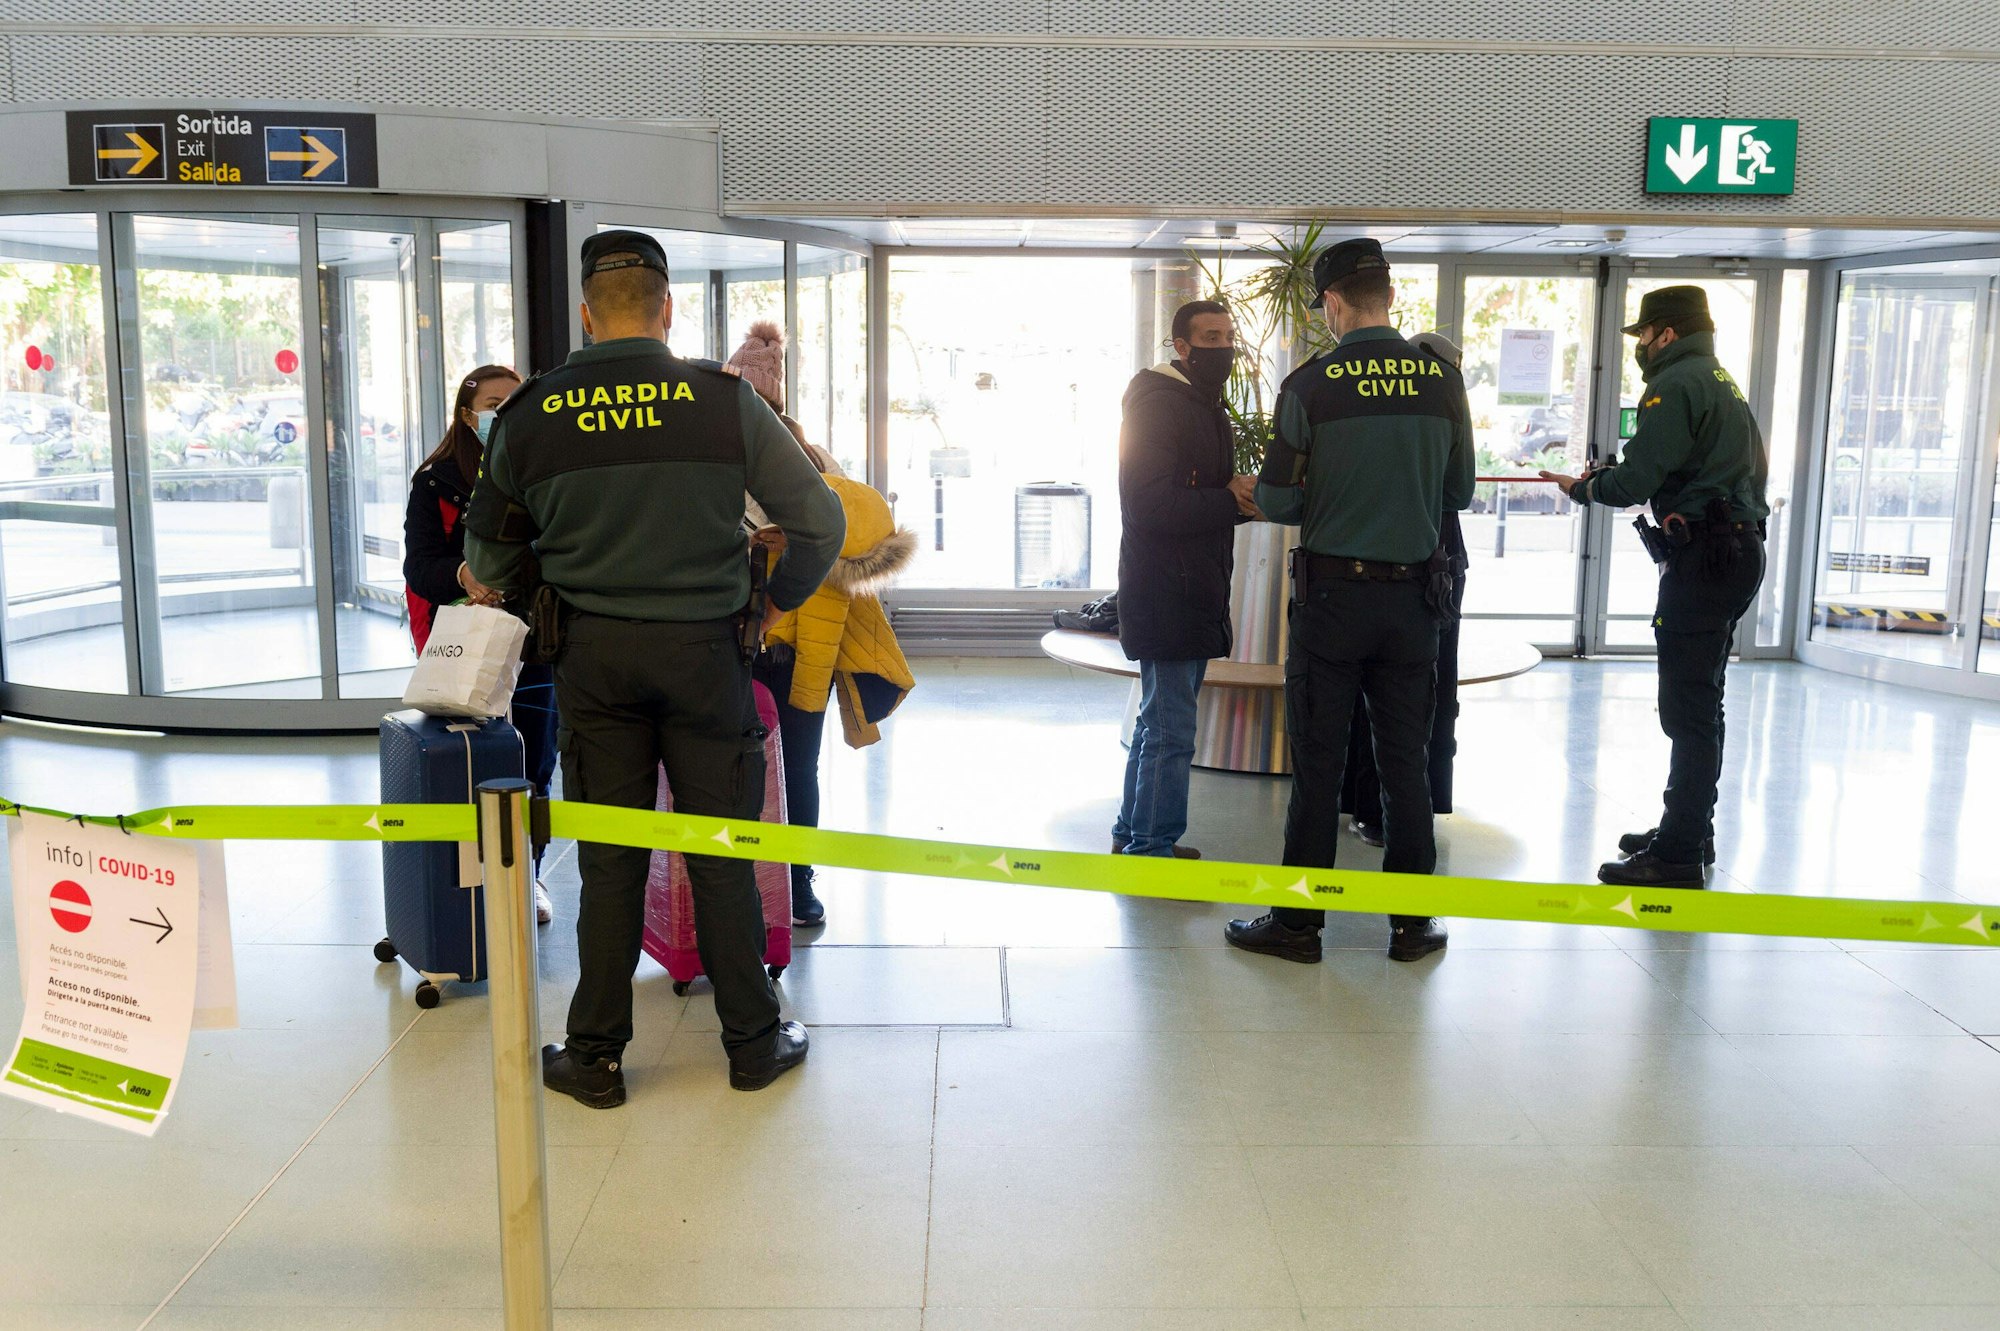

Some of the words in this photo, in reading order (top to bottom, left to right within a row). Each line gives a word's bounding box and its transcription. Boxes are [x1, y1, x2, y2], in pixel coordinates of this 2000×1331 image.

[177, 114, 252, 135] Sortida
[177, 139, 206, 156] Exit
[178, 161, 242, 182] Salida
[1325, 358, 1444, 379] GUARDIA
[542, 381, 695, 414] GUARDIA
[1357, 378, 1419, 397] CIVIL
[576, 406, 662, 432] CIVIL
[426, 644, 463, 658] MANGO
[175, 817, 194, 826] aena
[382, 817, 404, 827] aena
[734, 834, 760, 845] aena
[46, 841, 83, 867] info
[98, 856, 175, 887] COVID-19
[1013, 860, 1041, 871] aena
[1314, 884, 1344, 894] aena
[1639, 903, 1672, 914] aena
[49, 943, 72, 957] Accés
[74, 950, 84, 959] no
[85, 952, 128, 970] disponible.
[49, 956, 60, 965] Ves
[73, 962, 89, 971] porta
[48, 976, 78, 991] Acceso
[80, 985, 91, 994] no
[93, 988, 140, 1008] disponible.
[80, 996, 86, 1005] la
[87, 1000, 109, 1011] puerta
[110, 1005, 124, 1015] más
[125, 1010, 152, 1023] cercana.
[44, 1010, 78, 1028] Entrance
[78, 1021, 92, 1032] not
[93, 1025, 129, 1042] available.
[41, 1023, 61, 1035] Please
[61, 1029, 70, 1039] go
[71, 1032, 78, 1040] to
[79, 1033, 89, 1043] the
[90, 1038, 113, 1050] nearest
[130, 1084, 152, 1097] aena
